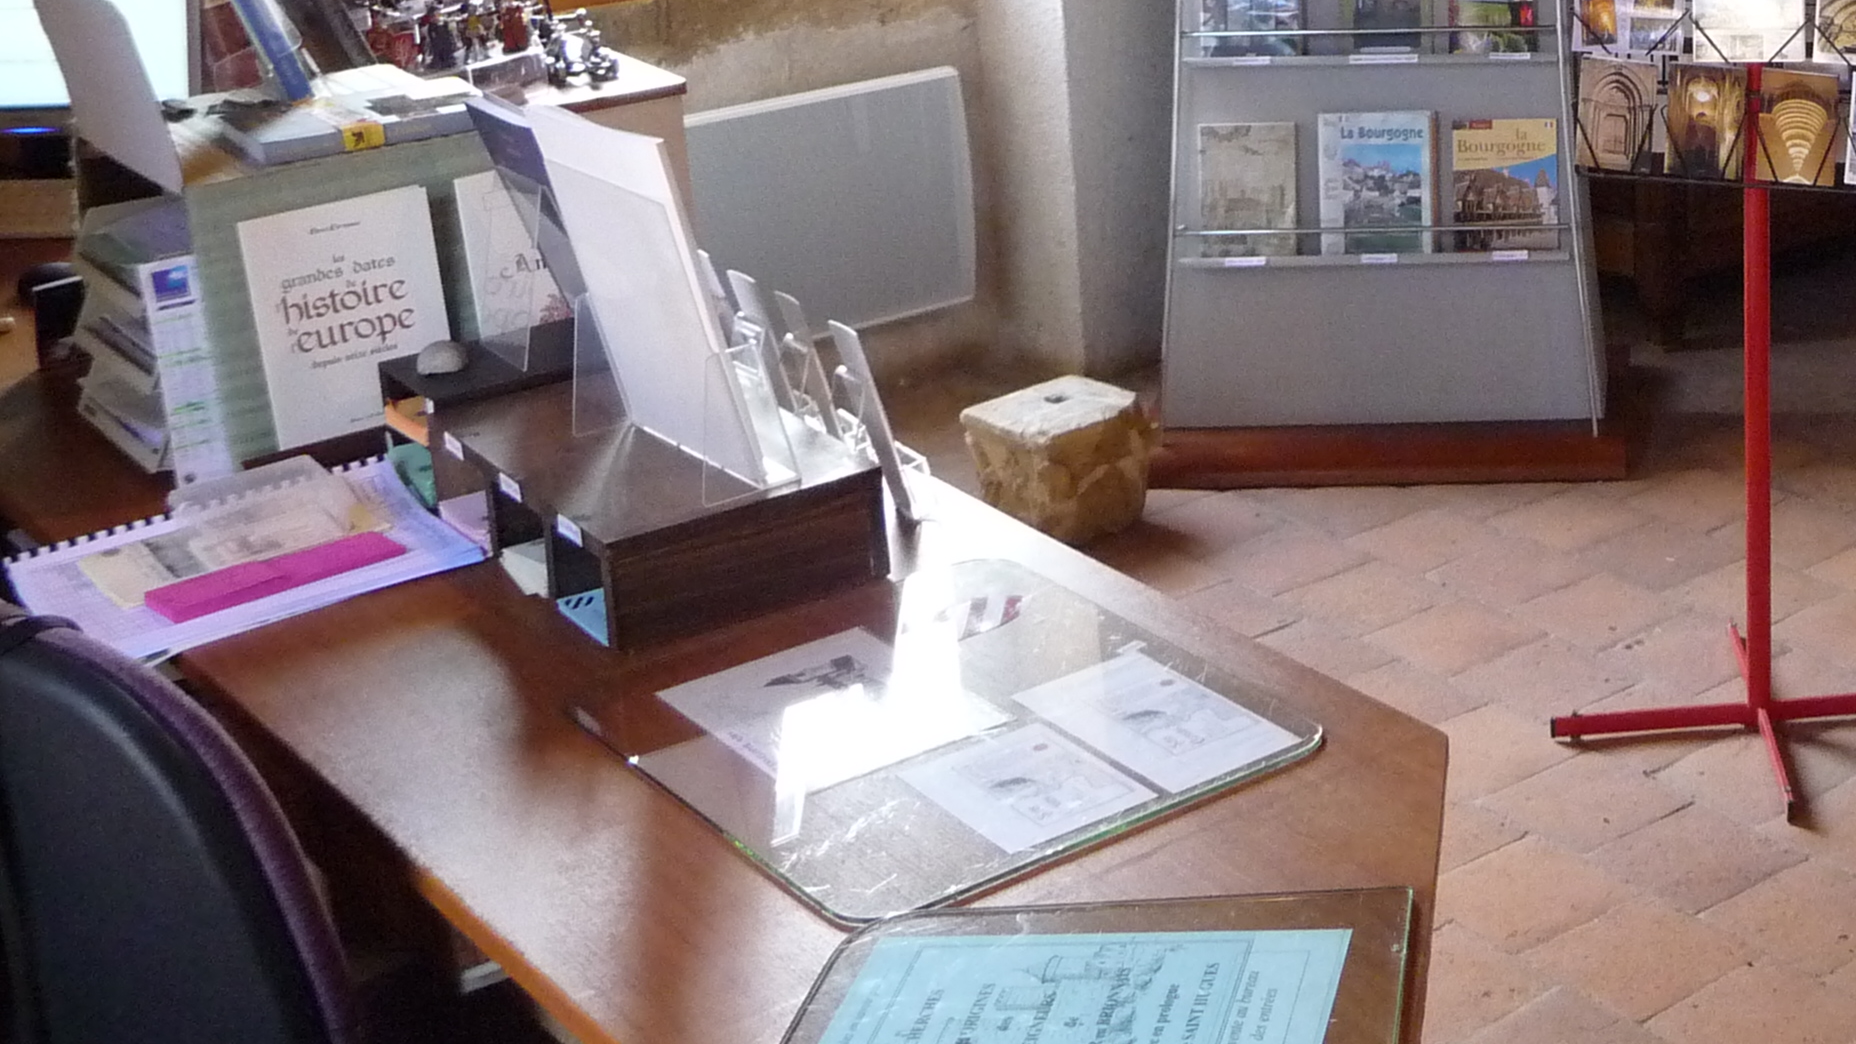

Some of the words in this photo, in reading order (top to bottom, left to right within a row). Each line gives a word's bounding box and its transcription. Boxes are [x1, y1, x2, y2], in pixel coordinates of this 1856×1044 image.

[1340, 126, 1354, 139] La
[1358, 126, 1424, 141] Bourgogne
[1457, 138, 1546, 156] Bourgogne
[1515, 128, 1528, 141] la
[281, 266, 344, 294] grandes
[353, 256, 396, 274] dates
[1157, 983, 1181, 1024] prologue
[1182, 1008, 1205, 1042] SAINT
[1194, 961, 1221, 1006] HUGUES
[1258, 987, 1279, 1023] entrées
[1022, 990, 1057, 1044] EIGNEURS
[1152, 1024, 1167, 1039] en
[1250, 1024, 1268, 1042] des
